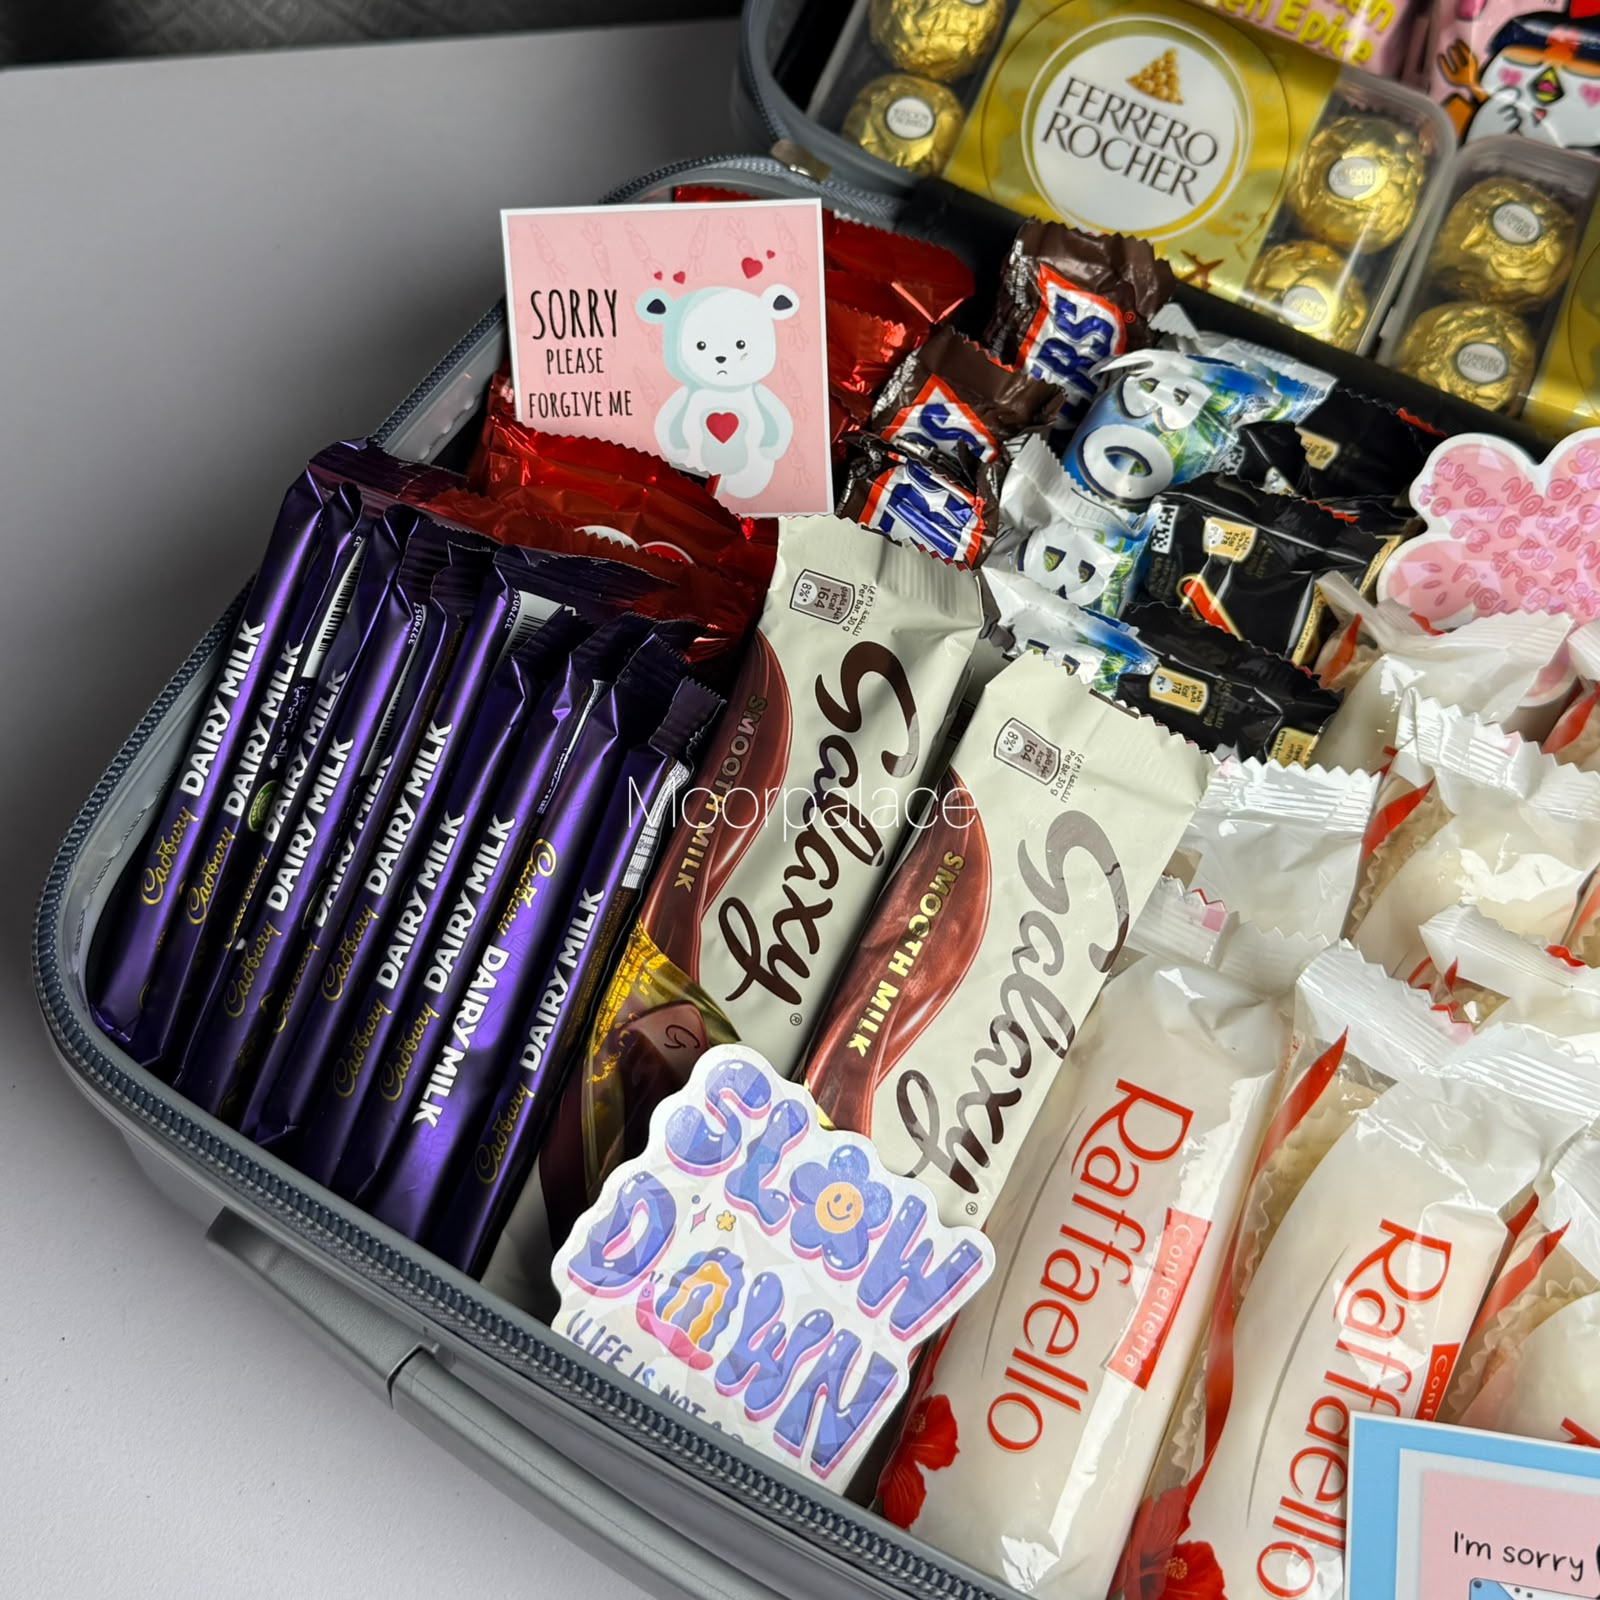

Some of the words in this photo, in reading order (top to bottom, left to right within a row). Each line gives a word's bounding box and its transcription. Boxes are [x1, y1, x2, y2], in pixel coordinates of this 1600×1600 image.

[1041, 110, 1199, 205] ROCHER
[1058, 76, 1218, 168] FERRERO
[530, 288, 617, 340] SORRY
[546, 347, 604, 376] PLEASE
[528, 391, 602, 419] FORGIVE
[608, 390, 633, 417] ME
[814, 586, 831, 609] 164
[828, 592, 840, 611] kcal
[140, 806, 199, 905] Cadbury
[179, 695, 231, 798] DAIRY
[218, 619, 266, 699] MILK
[186, 826, 236, 925] Cadbury
[223, 715, 271, 817] DAIRY
[259, 639, 305, 720] MILK
[263, 743, 309, 843] DAIRY
[303, 669, 348, 746] MILK
[704, 695, 768, 812] SMOOTH
[1020, 739, 1038, 763] 164
[223, 919, 282, 1018] Cadbury
[265, 811, 317, 912] DAIRY
[306, 735, 355, 815] MILK
[321, 903, 380, 1002] Cadbury
[364, 796, 413, 896] DAIRY
[412, 719, 453, 799] MILK
[673, 822, 716, 893] MILK
[719, 640, 921, 1005] Galaxy
[333, 998, 393, 1098] Cadbury
[375, 885, 428, 990] DAIRY
[418, 809, 466, 891] MILK
[379, 1002, 440, 1103] Cadbury
[423, 891, 478, 994] DAIRY
[465, 813, 516, 894] MILK
[888, 850, 965, 977] SMOOTH
[452, 943, 511, 1050] DAIRY
[474, 1081, 536, 1184] Cadbury
[519, 967, 570, 1072] DAIRY
[558, 887, 605, 970] MILK
[847, 979, 900, 1057] MILK
[896, 810, 1130, 1194] Galaxy
[412, 1047, 466, 1129] MILK
[987, 1078, 1194, 1453] Raffaello
[1453, 1530, 1491, 1560] I'm
[1502, 1545, 1584, 1582] sorry
